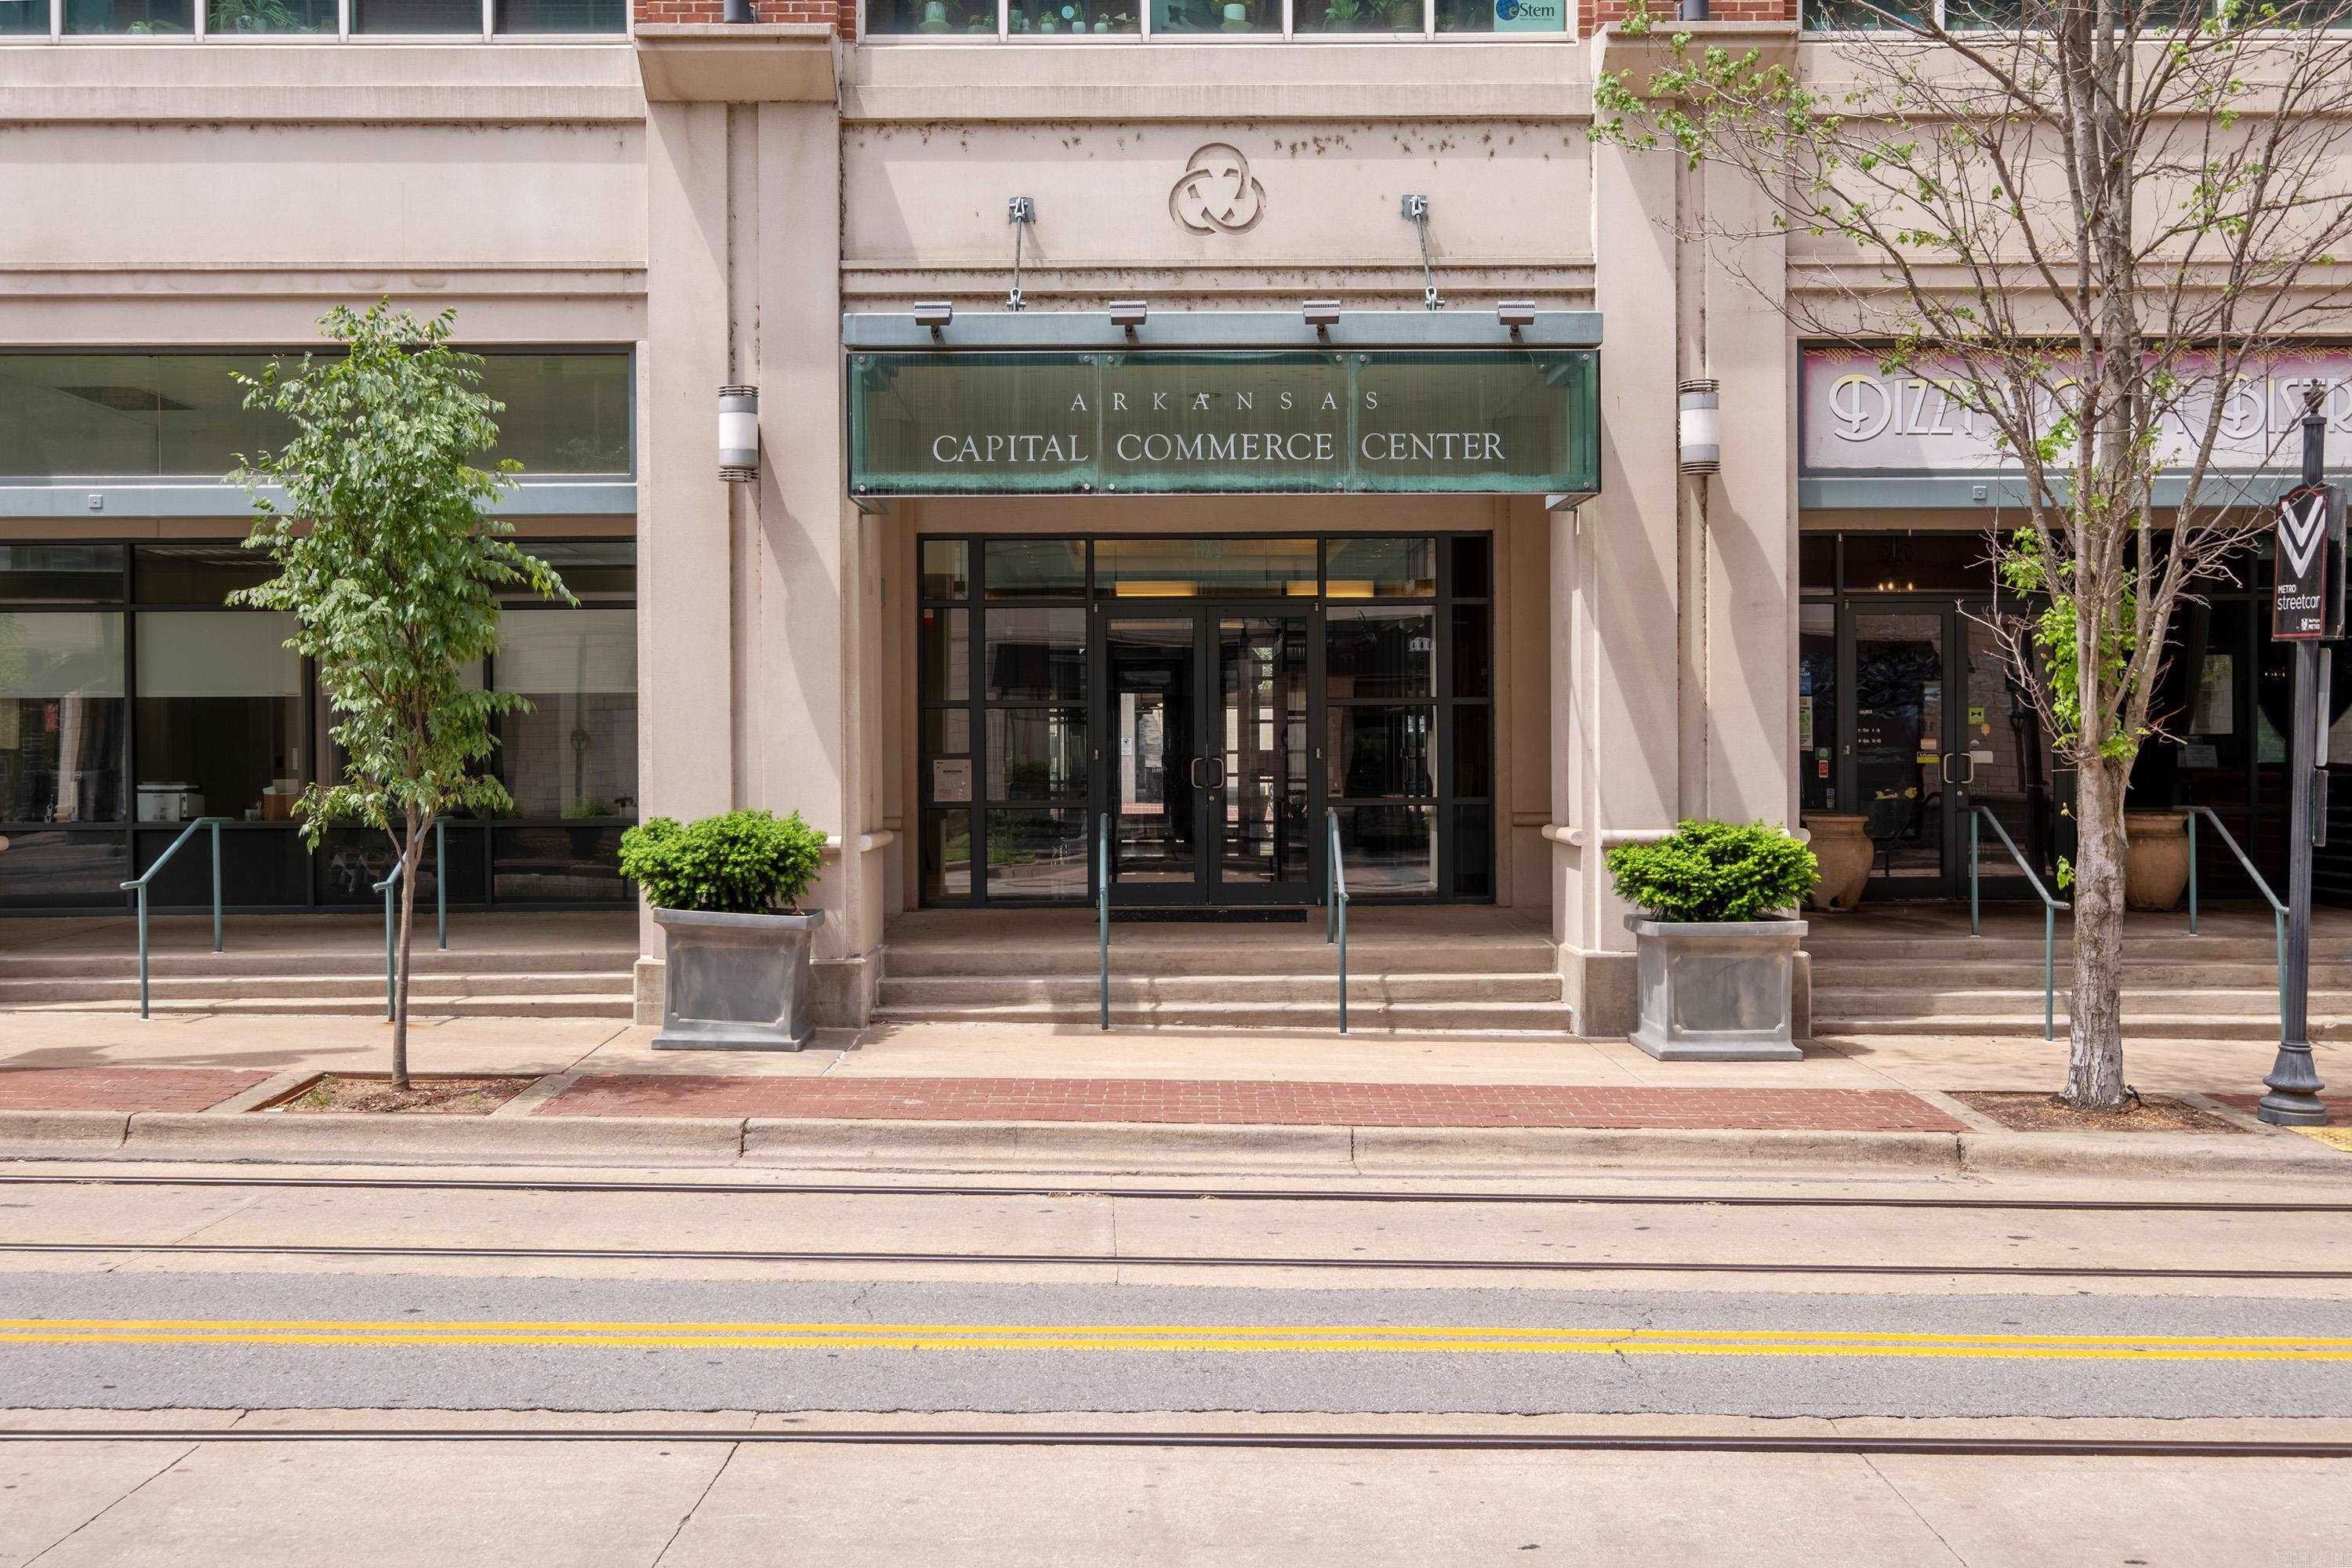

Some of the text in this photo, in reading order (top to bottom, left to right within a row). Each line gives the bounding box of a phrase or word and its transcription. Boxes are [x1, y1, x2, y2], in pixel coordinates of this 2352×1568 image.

[1509, 2, 1555, 16] eStem
[1070, 391, 1378, 411] ARKANSAS
[932, 432, 1506, 463] CAPITAL COMMERCE CENTER
[2278, 584, 2296, 593] METRO
[2277, 594, 2321, 611] streetcar
